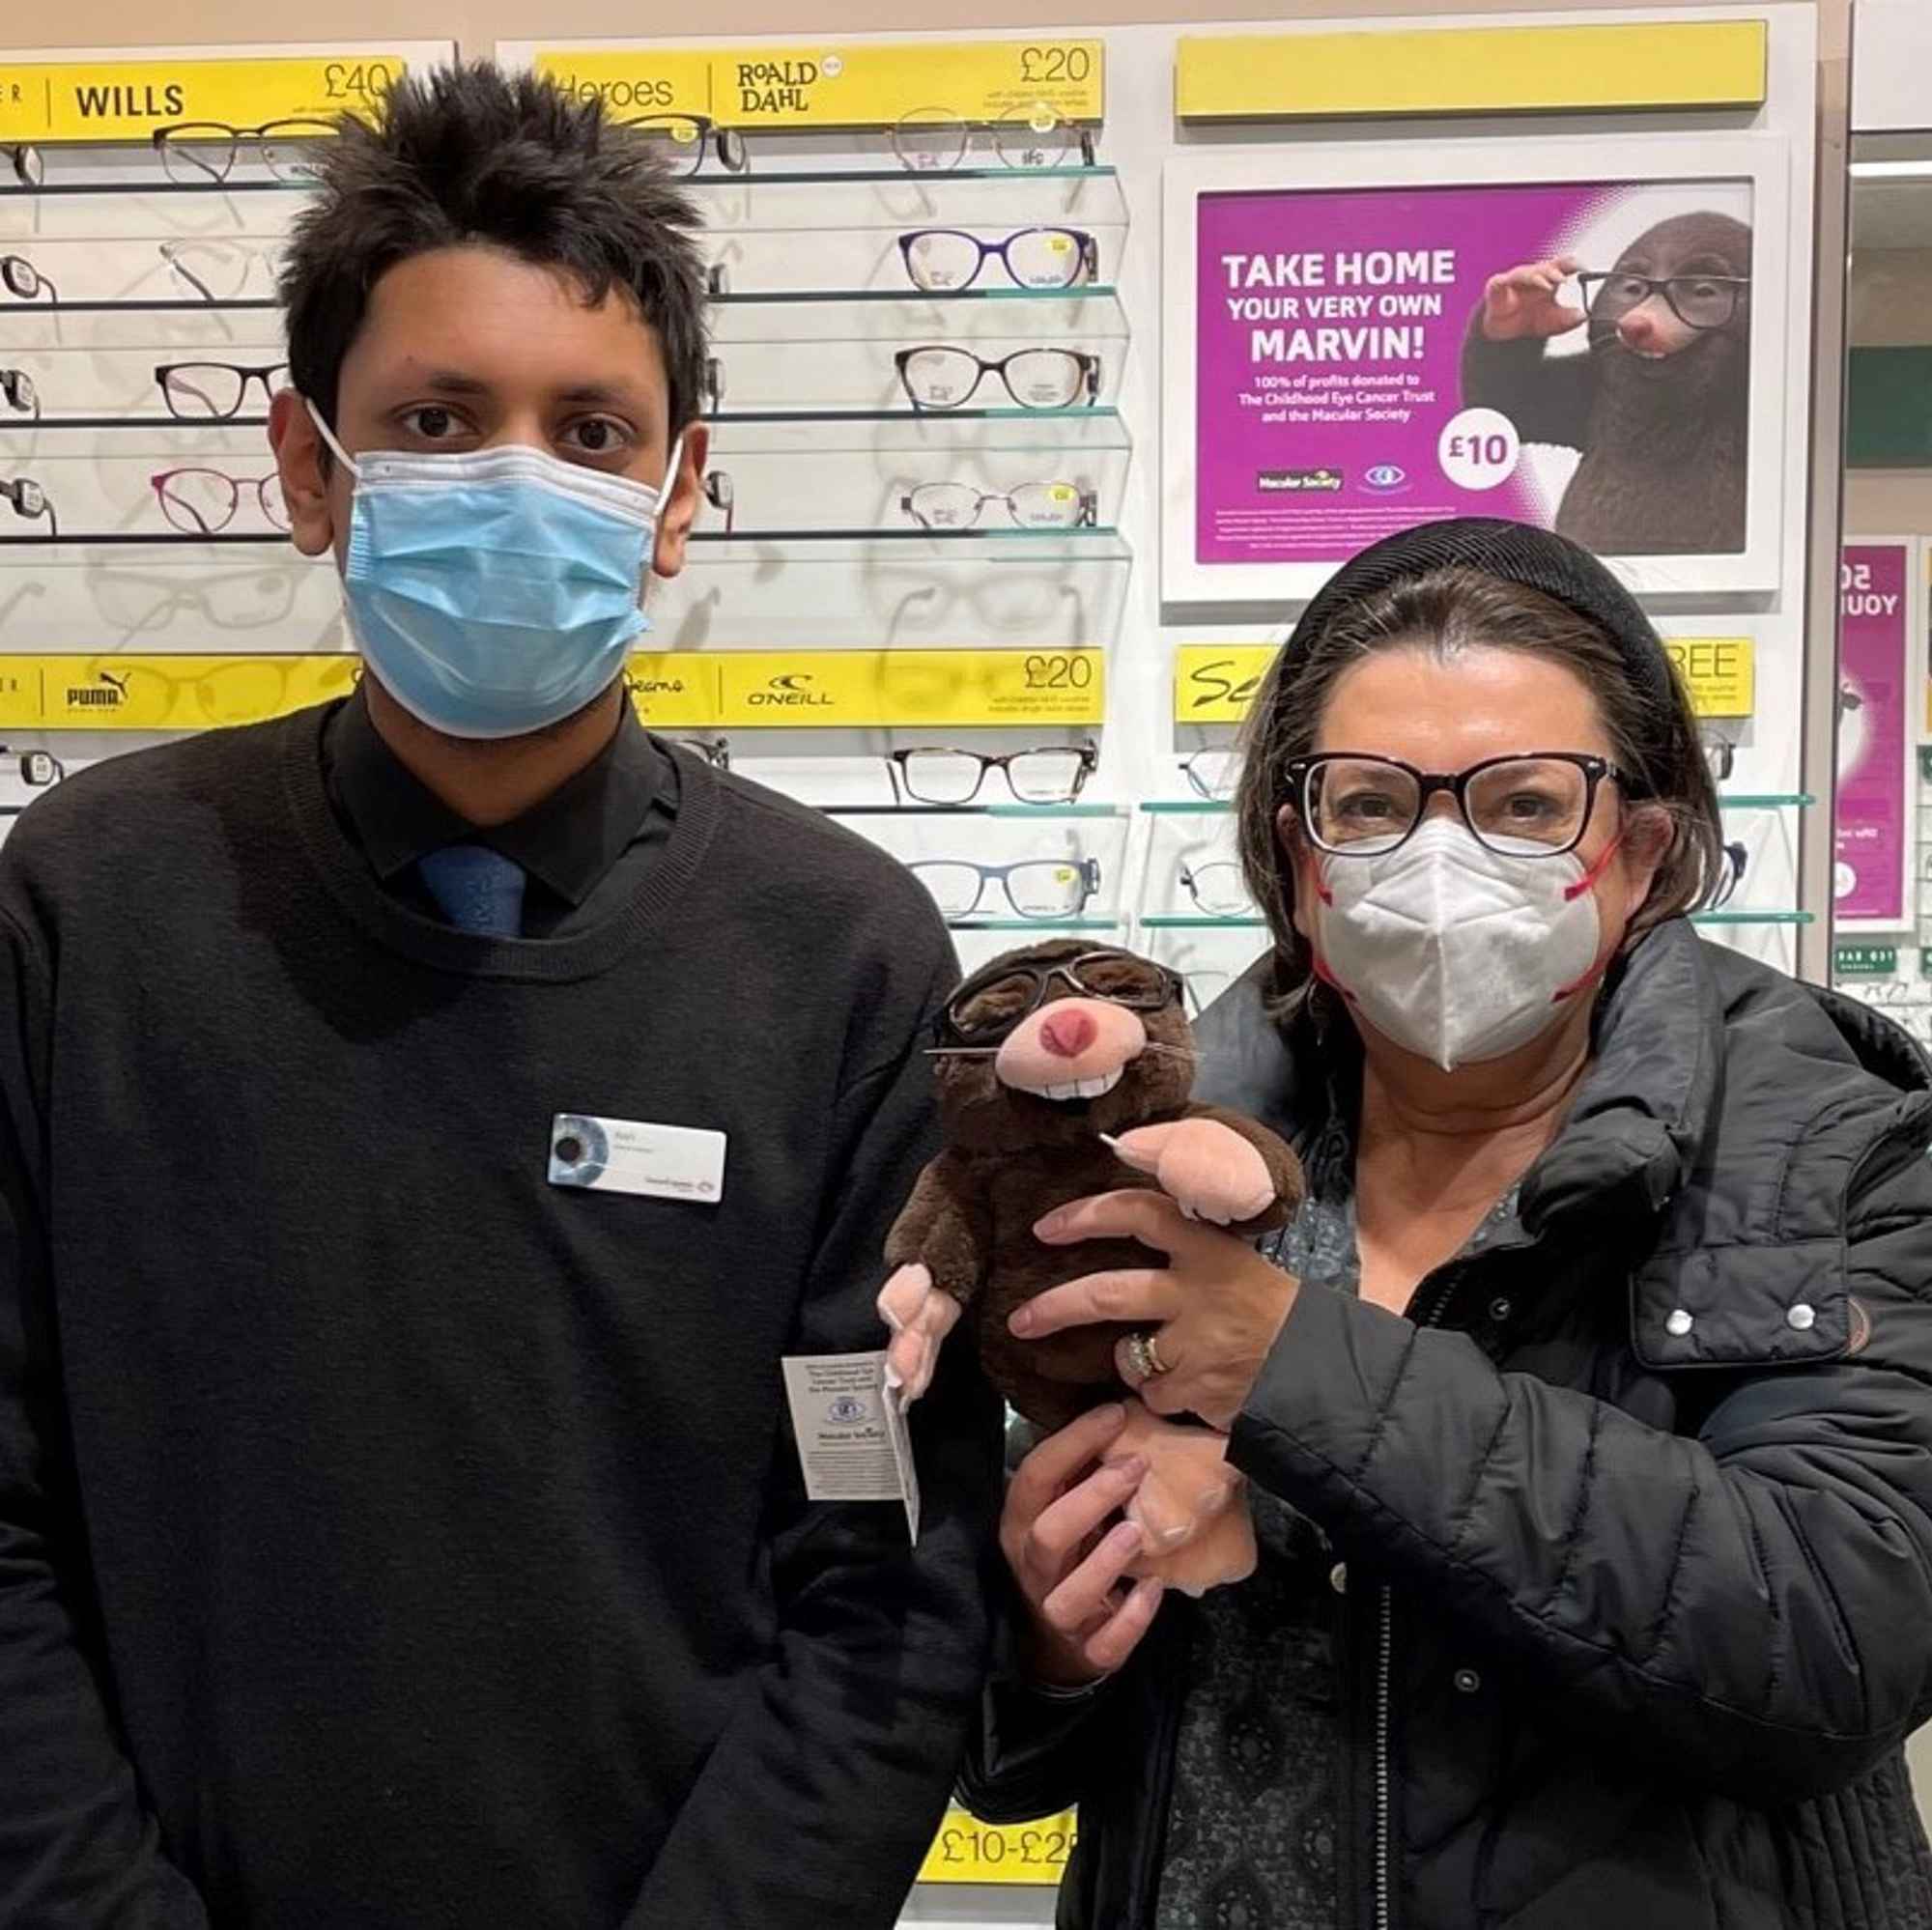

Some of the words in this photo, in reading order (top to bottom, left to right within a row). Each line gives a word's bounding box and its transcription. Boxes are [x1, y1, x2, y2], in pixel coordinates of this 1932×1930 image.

[737, 61, 818, 88] ROALD
[1020, 46, 1091, 83] £20
[75, 84, 185, 117] WILLS
[741, 88, 810, 113] DAHL
[1221, 253, 1326, 289] TAKE
[1334, 249, 1456, 286] HOME
[1227, 298, 1299, 321] YOUR
[1305, 295, 1374, 319] VERY
[1378, 294, 1442, 317] OWN
[1251, 326, 1425, 363] MARVIN!
[1255, 376, 1292, 389] 100%
[1293, 374, 1308, 388] of
[1308, 374, 1350, 391] profits
[1351, 373, 1405, 387] donated
[1406, 374, 1420, 386] to
[1237, 392, 1263, 407] The
[1264, 391, 1328, 406] Childhood
[1331, 391, 1353, 407] Eye
[1355, 390, 1400, 404] Cancer
[1403, 388, 1436, 403] Trust
[1262, 411, 1287, 423] and
[1289, 410, 1310, 422] the
[1312, 409, 1362, 421] Macular
[1364, 408, 1411, 423] Society
[1449, 434, 1508, 466] £10
[1024, 655, 1093, 690] £20
